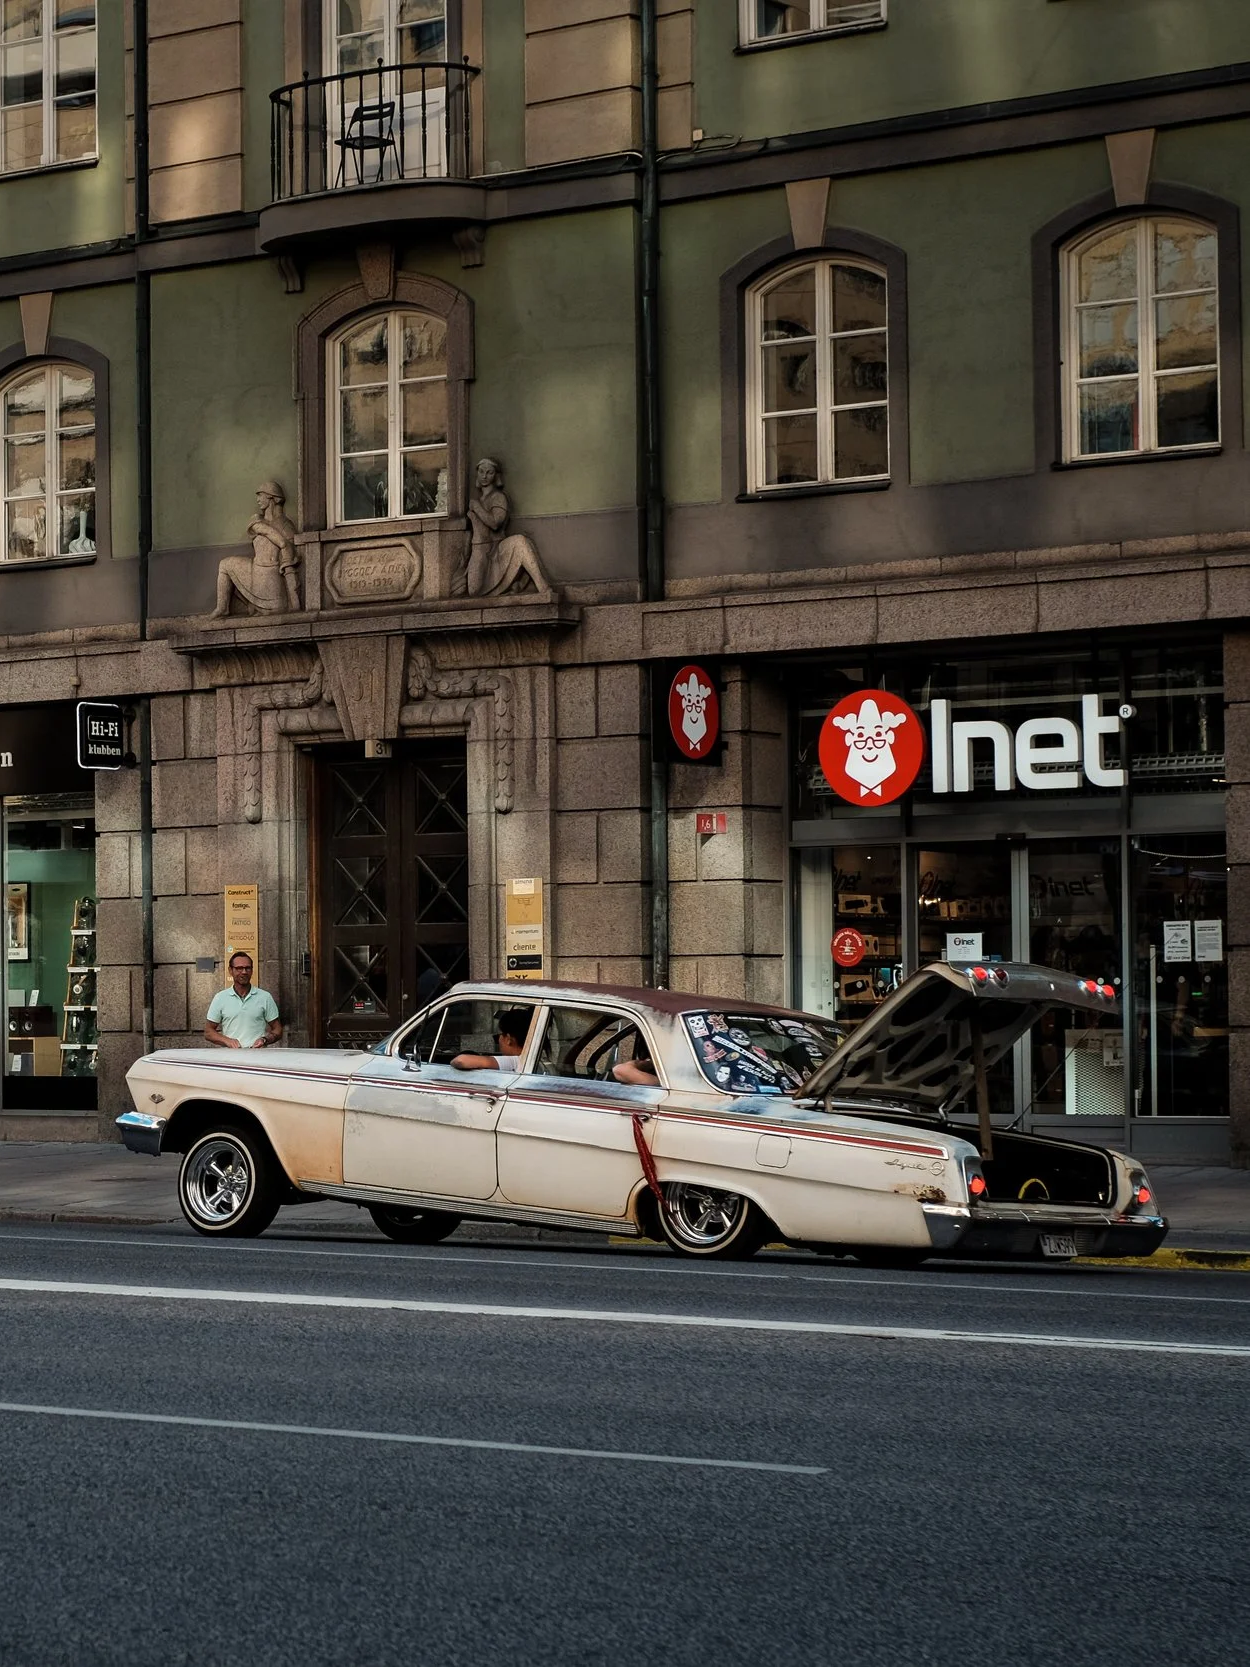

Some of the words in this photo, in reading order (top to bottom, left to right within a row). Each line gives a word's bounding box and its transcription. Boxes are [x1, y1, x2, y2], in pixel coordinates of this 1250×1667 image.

[91, 720, 119, 737] Hi-Fi
[88, 744, 121, 756] klubben
[375, 742, 387, 755] 31
[931, 694, 1127, 793] Inet
